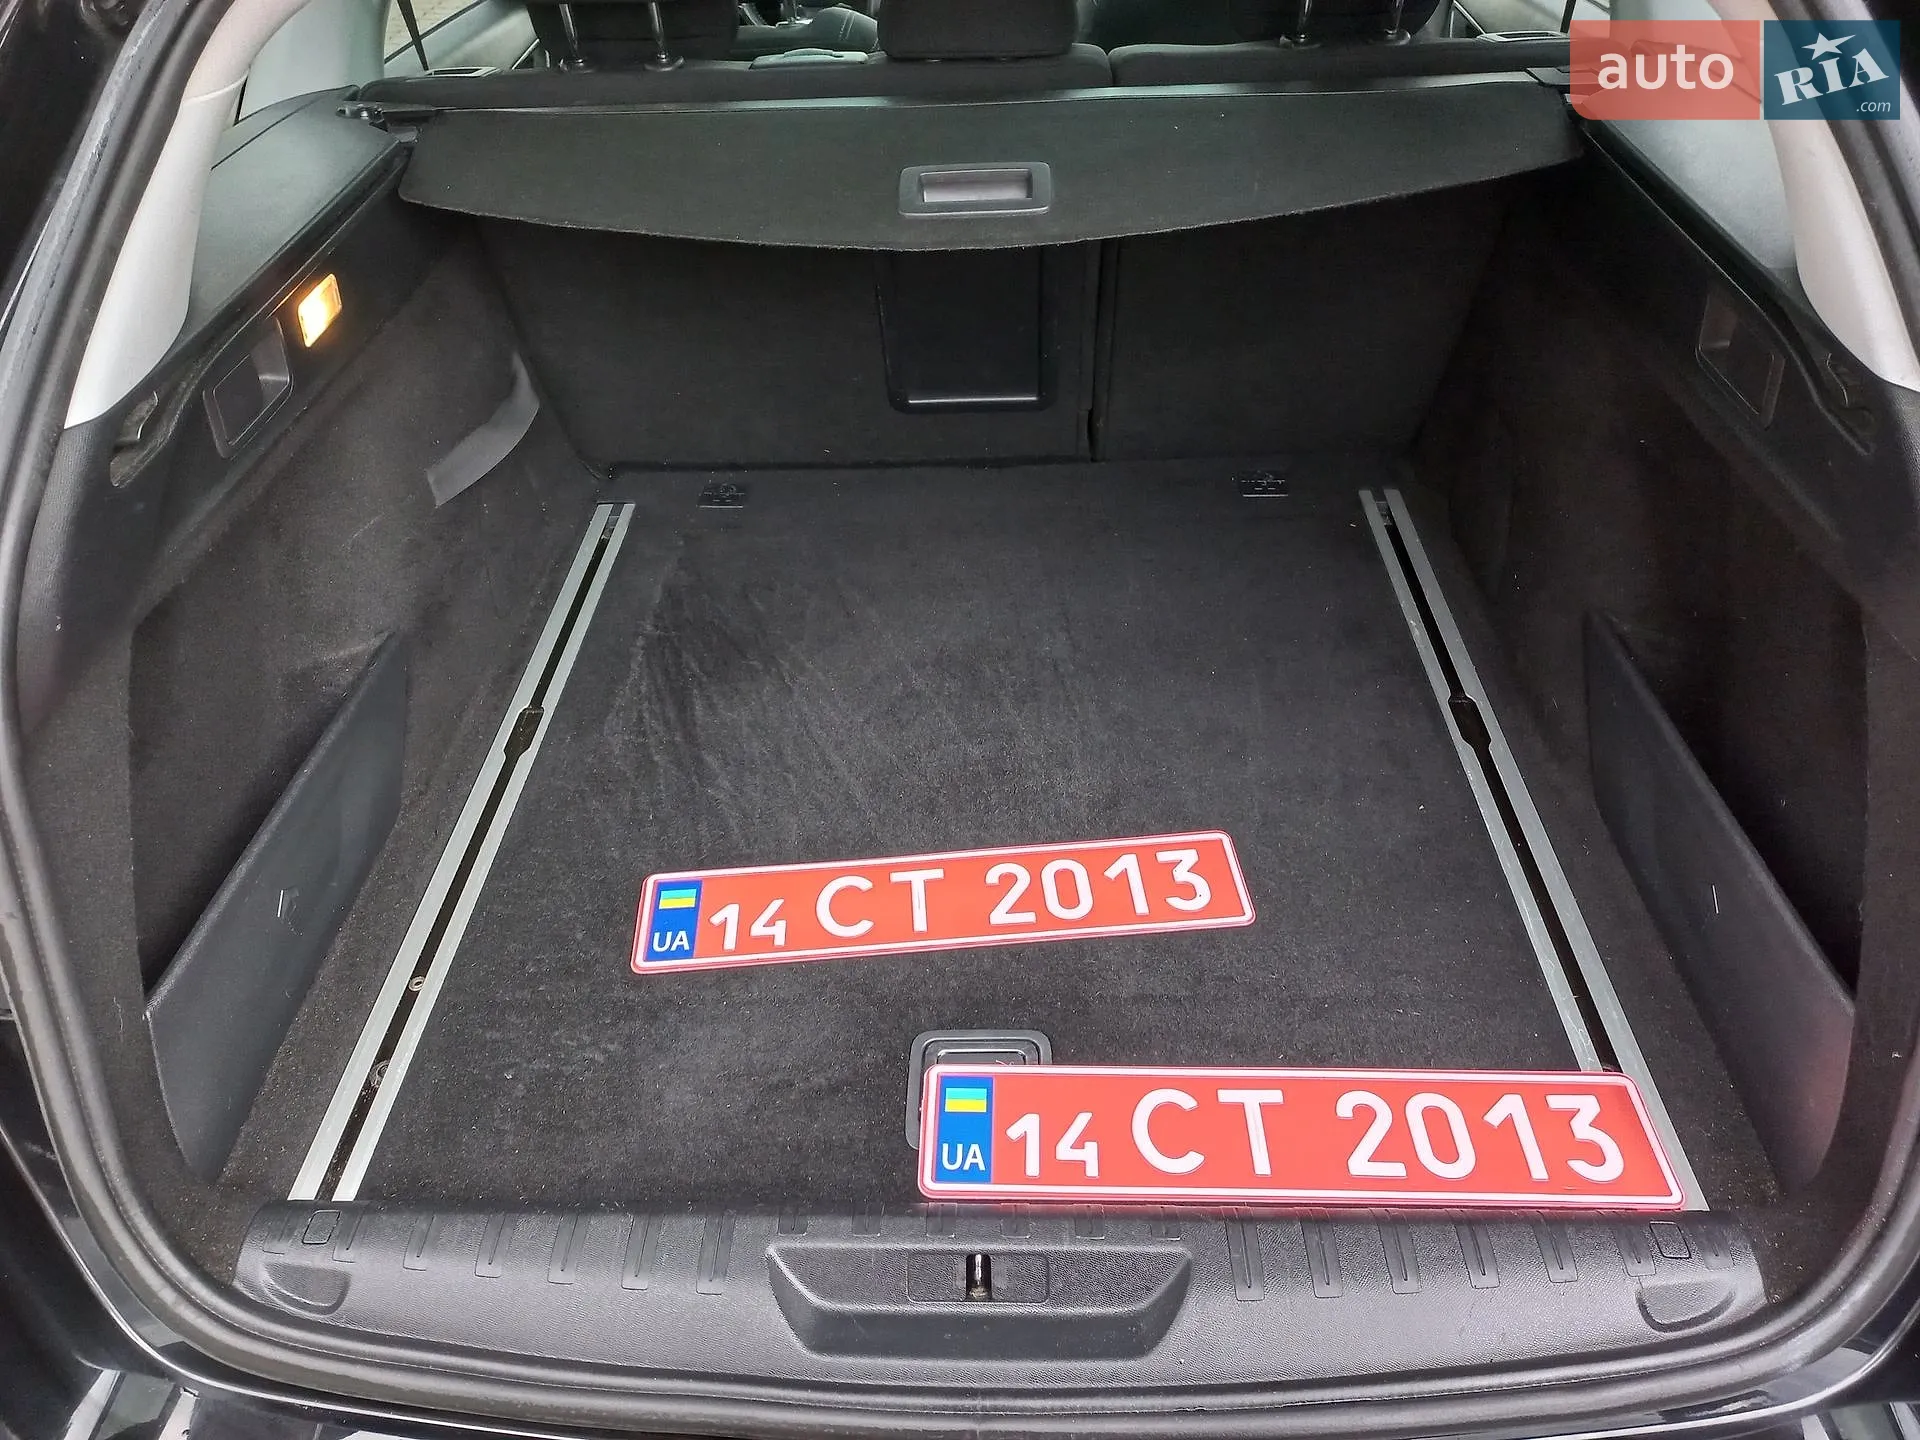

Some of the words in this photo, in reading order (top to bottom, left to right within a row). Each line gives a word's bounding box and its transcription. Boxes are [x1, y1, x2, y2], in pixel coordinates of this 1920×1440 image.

[709, 899, 787, 951] 14
[816, 869, 944, 937] CT
[985, 848, 1211, 926] 2013
[652, 930, 690, 953] UA
[941, 1144, 986, 1172] UA
[1005, 1112, 1099, 1179] 14
[1131, 1088, 1283, 1176] CT
[1335, 1090, 1624, 1183] 2013
